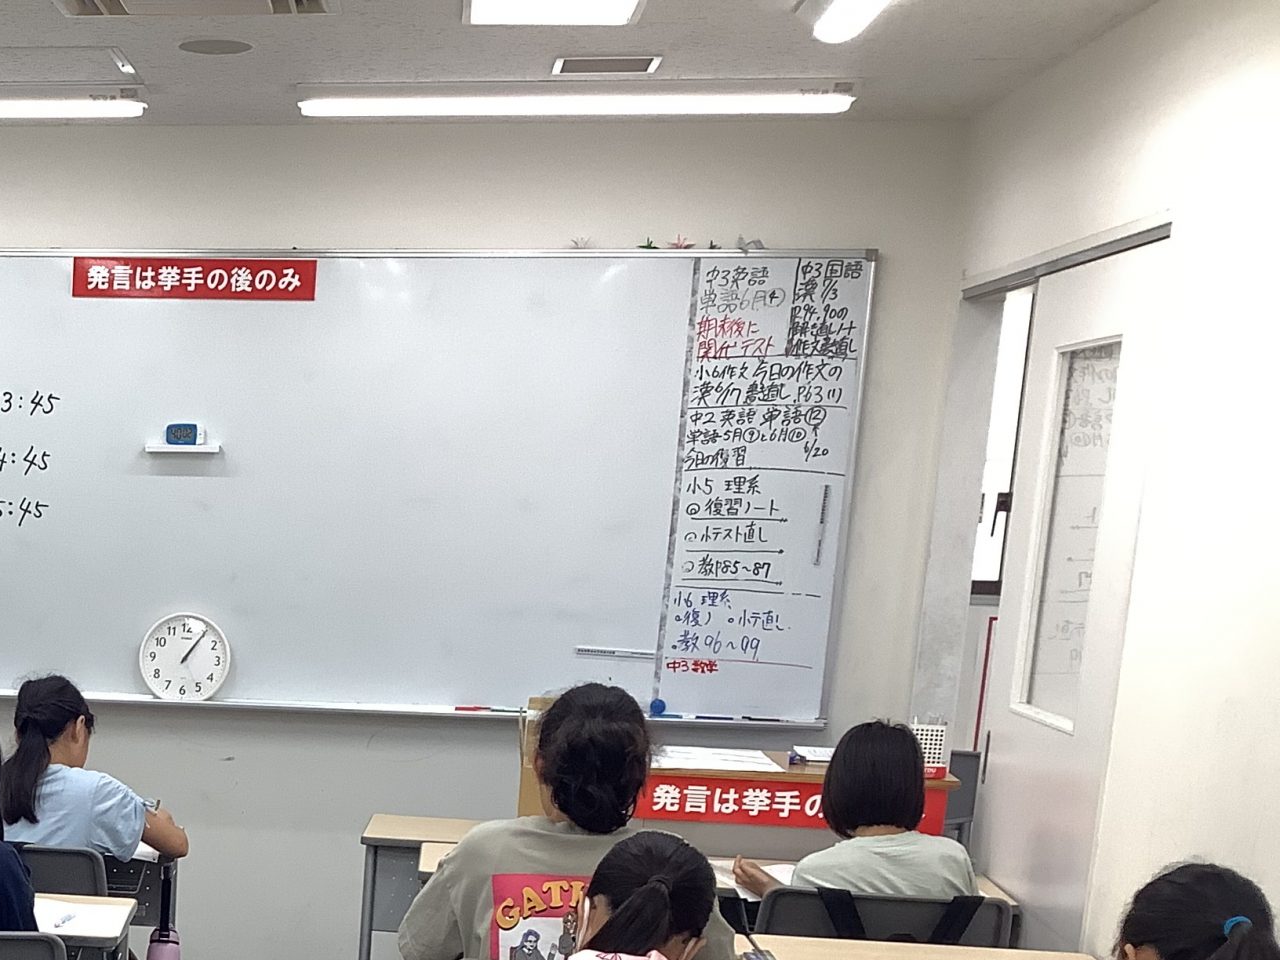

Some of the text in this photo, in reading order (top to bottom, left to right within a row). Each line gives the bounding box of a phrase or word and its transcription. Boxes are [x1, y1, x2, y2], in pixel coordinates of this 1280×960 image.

[87, 265, 301, 292] 発言は挙手の後のみ
[167, 626, 176, 636] 11
[155, 637, 166, 647] 10
[211, 640, 217, 651] 2
[149, 651, 156, 661] 9
[214, 656, 221, 666] 3
[153, 668, 160, 678] 8
[206, 673, 213, 682] 4
[164, 680, 172, 690] 7
[179, 685, 186, 695] 6
[195, 682, 202, 692] 5
[652, 784, 824, 818] 発言は挙手の
